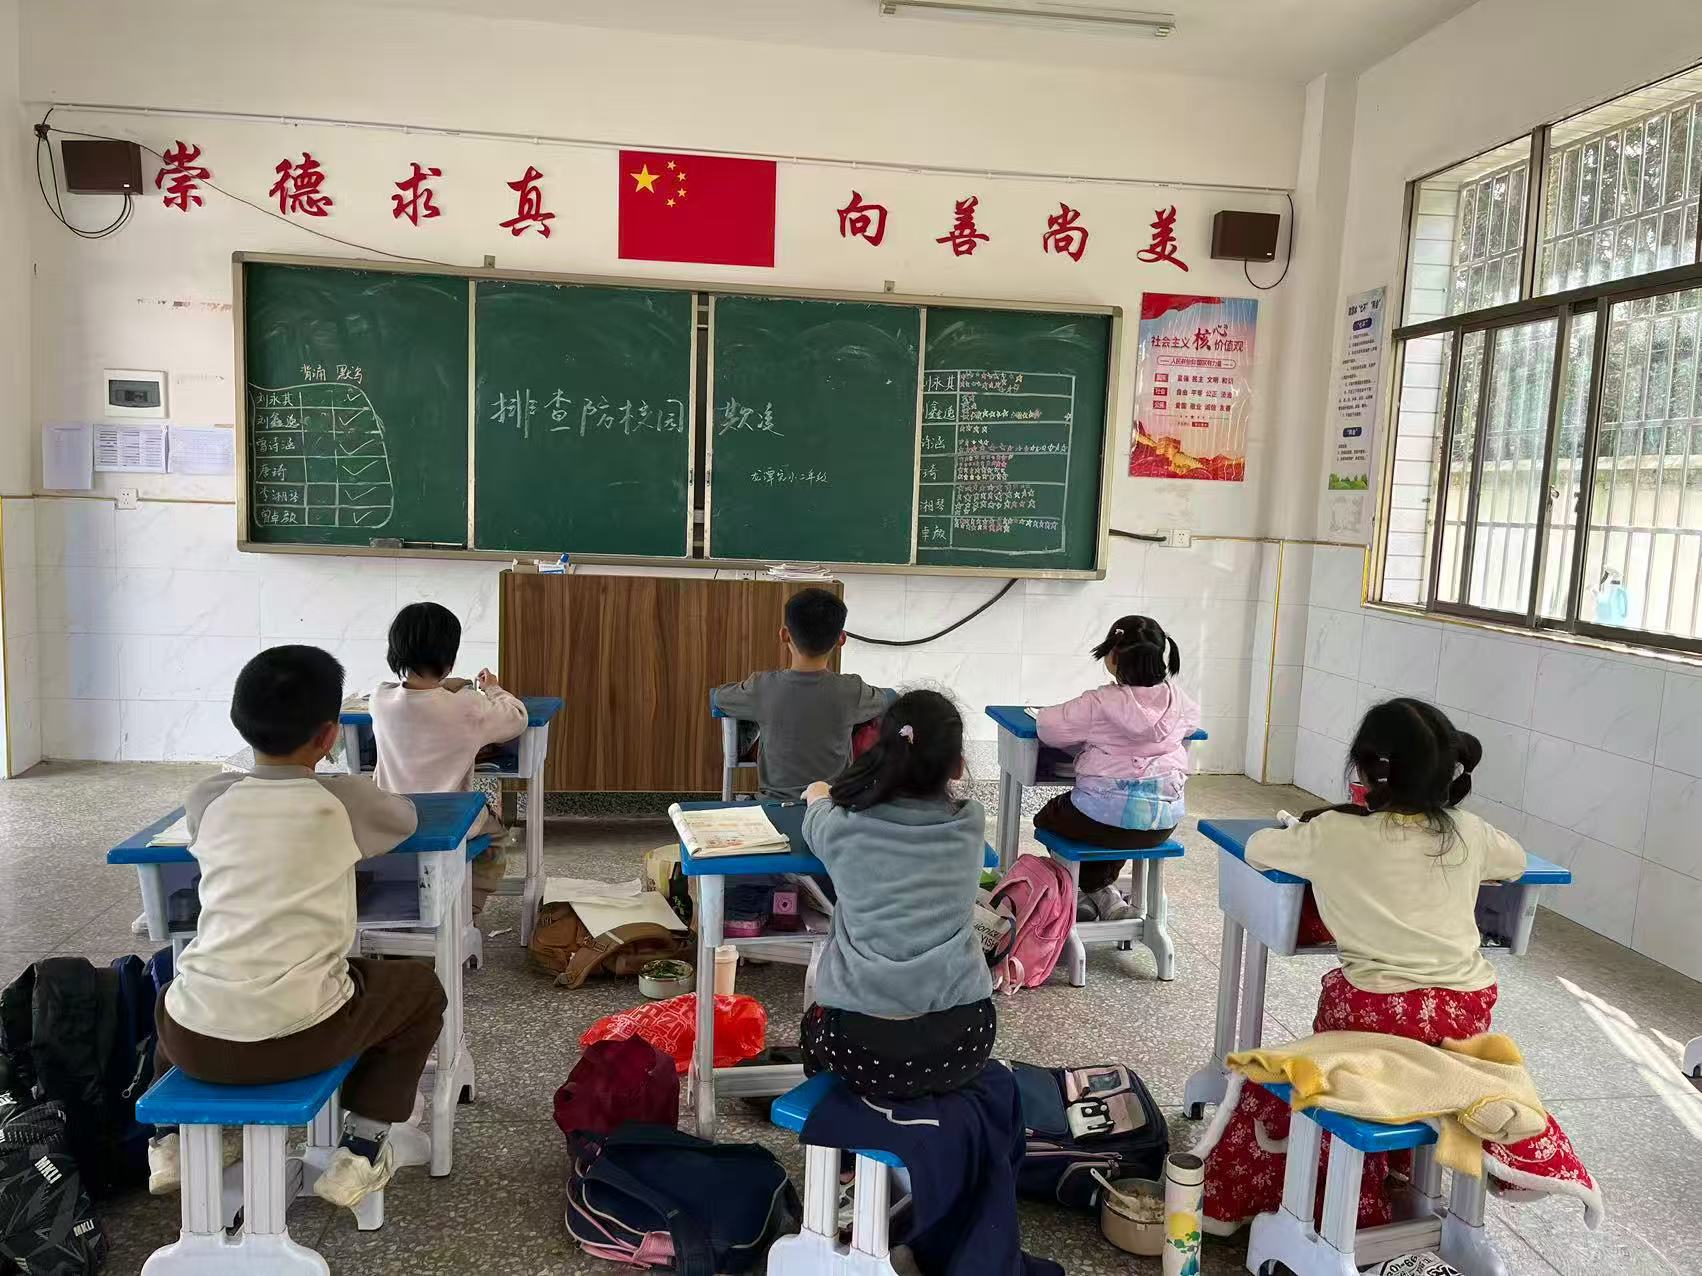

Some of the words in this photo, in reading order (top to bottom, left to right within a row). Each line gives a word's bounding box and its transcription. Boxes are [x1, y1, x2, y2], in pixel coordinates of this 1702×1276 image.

[154, 140, 557, 240] 崇德求真
[837, 189, 1190, 272] 向善尚美
[1176, 388, 1188, 396] 自由
[1206, 390, 1217, 398] 公正
[1192, 375, 1204, 383] 民主
[1207, 376, 1219, 384] 文明
[489, 388, 686, 440] 排查防校园
